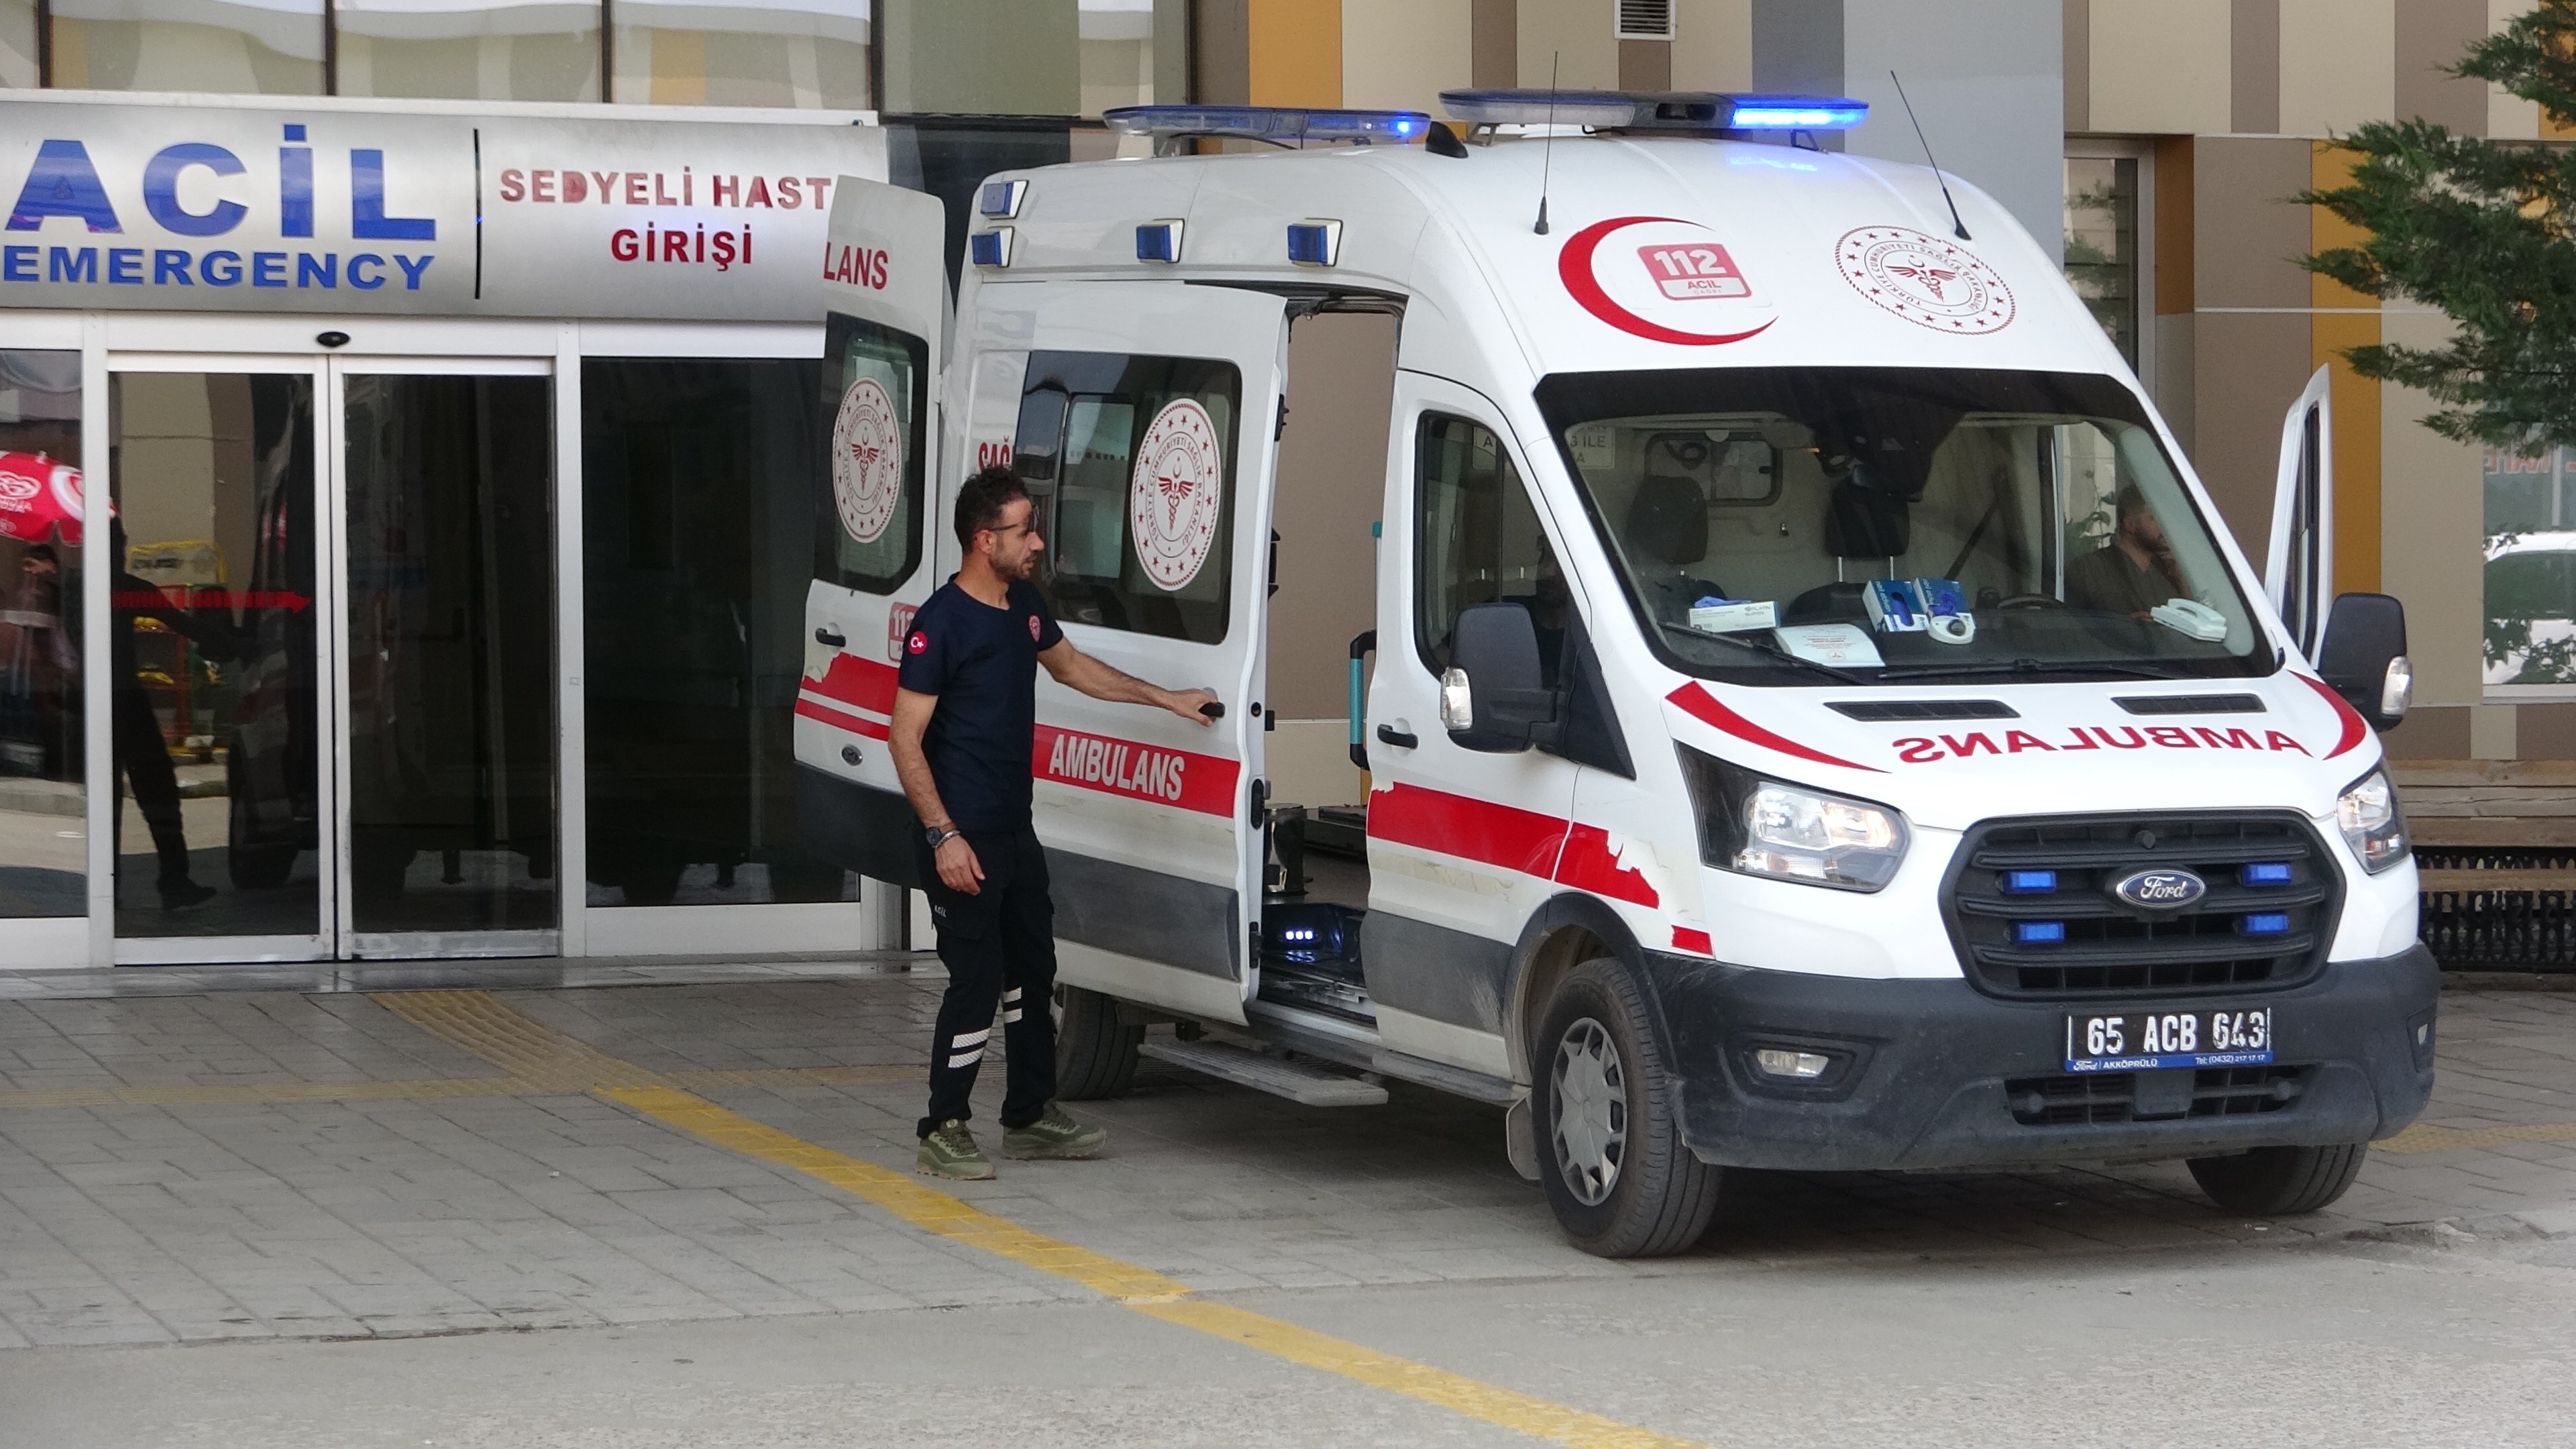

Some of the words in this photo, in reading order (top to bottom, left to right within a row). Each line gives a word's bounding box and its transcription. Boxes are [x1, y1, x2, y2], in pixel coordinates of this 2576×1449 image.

[5, 123, 436, 241] ACİL
[500, 166, 693, 207] SEDYELİ
[3, 245, 435, 290] EMERGENCY
[611, 221, 752, 271] GİRİŞİ
[823, 241, 888, 290] LANS
[1653, 249, 1727, 276] 112
[1687, 280, 1722, 290] ACİL
[1049, 734, 1185, 801] AMBULANS
[2140, 876, 2188, 899] Ford
[2087, 1017, 2124, 1055] 65
[2143, 1014, 2197, 1053] ACB
[2212, 1011, 2266, 1050] 643
[2073, 1061, 2098, 1071] Ford
[2103, 1058, 2158, 1069] AKKÖPRÜLÜ
[2208, 1055, 2234, 1065] (0432)
